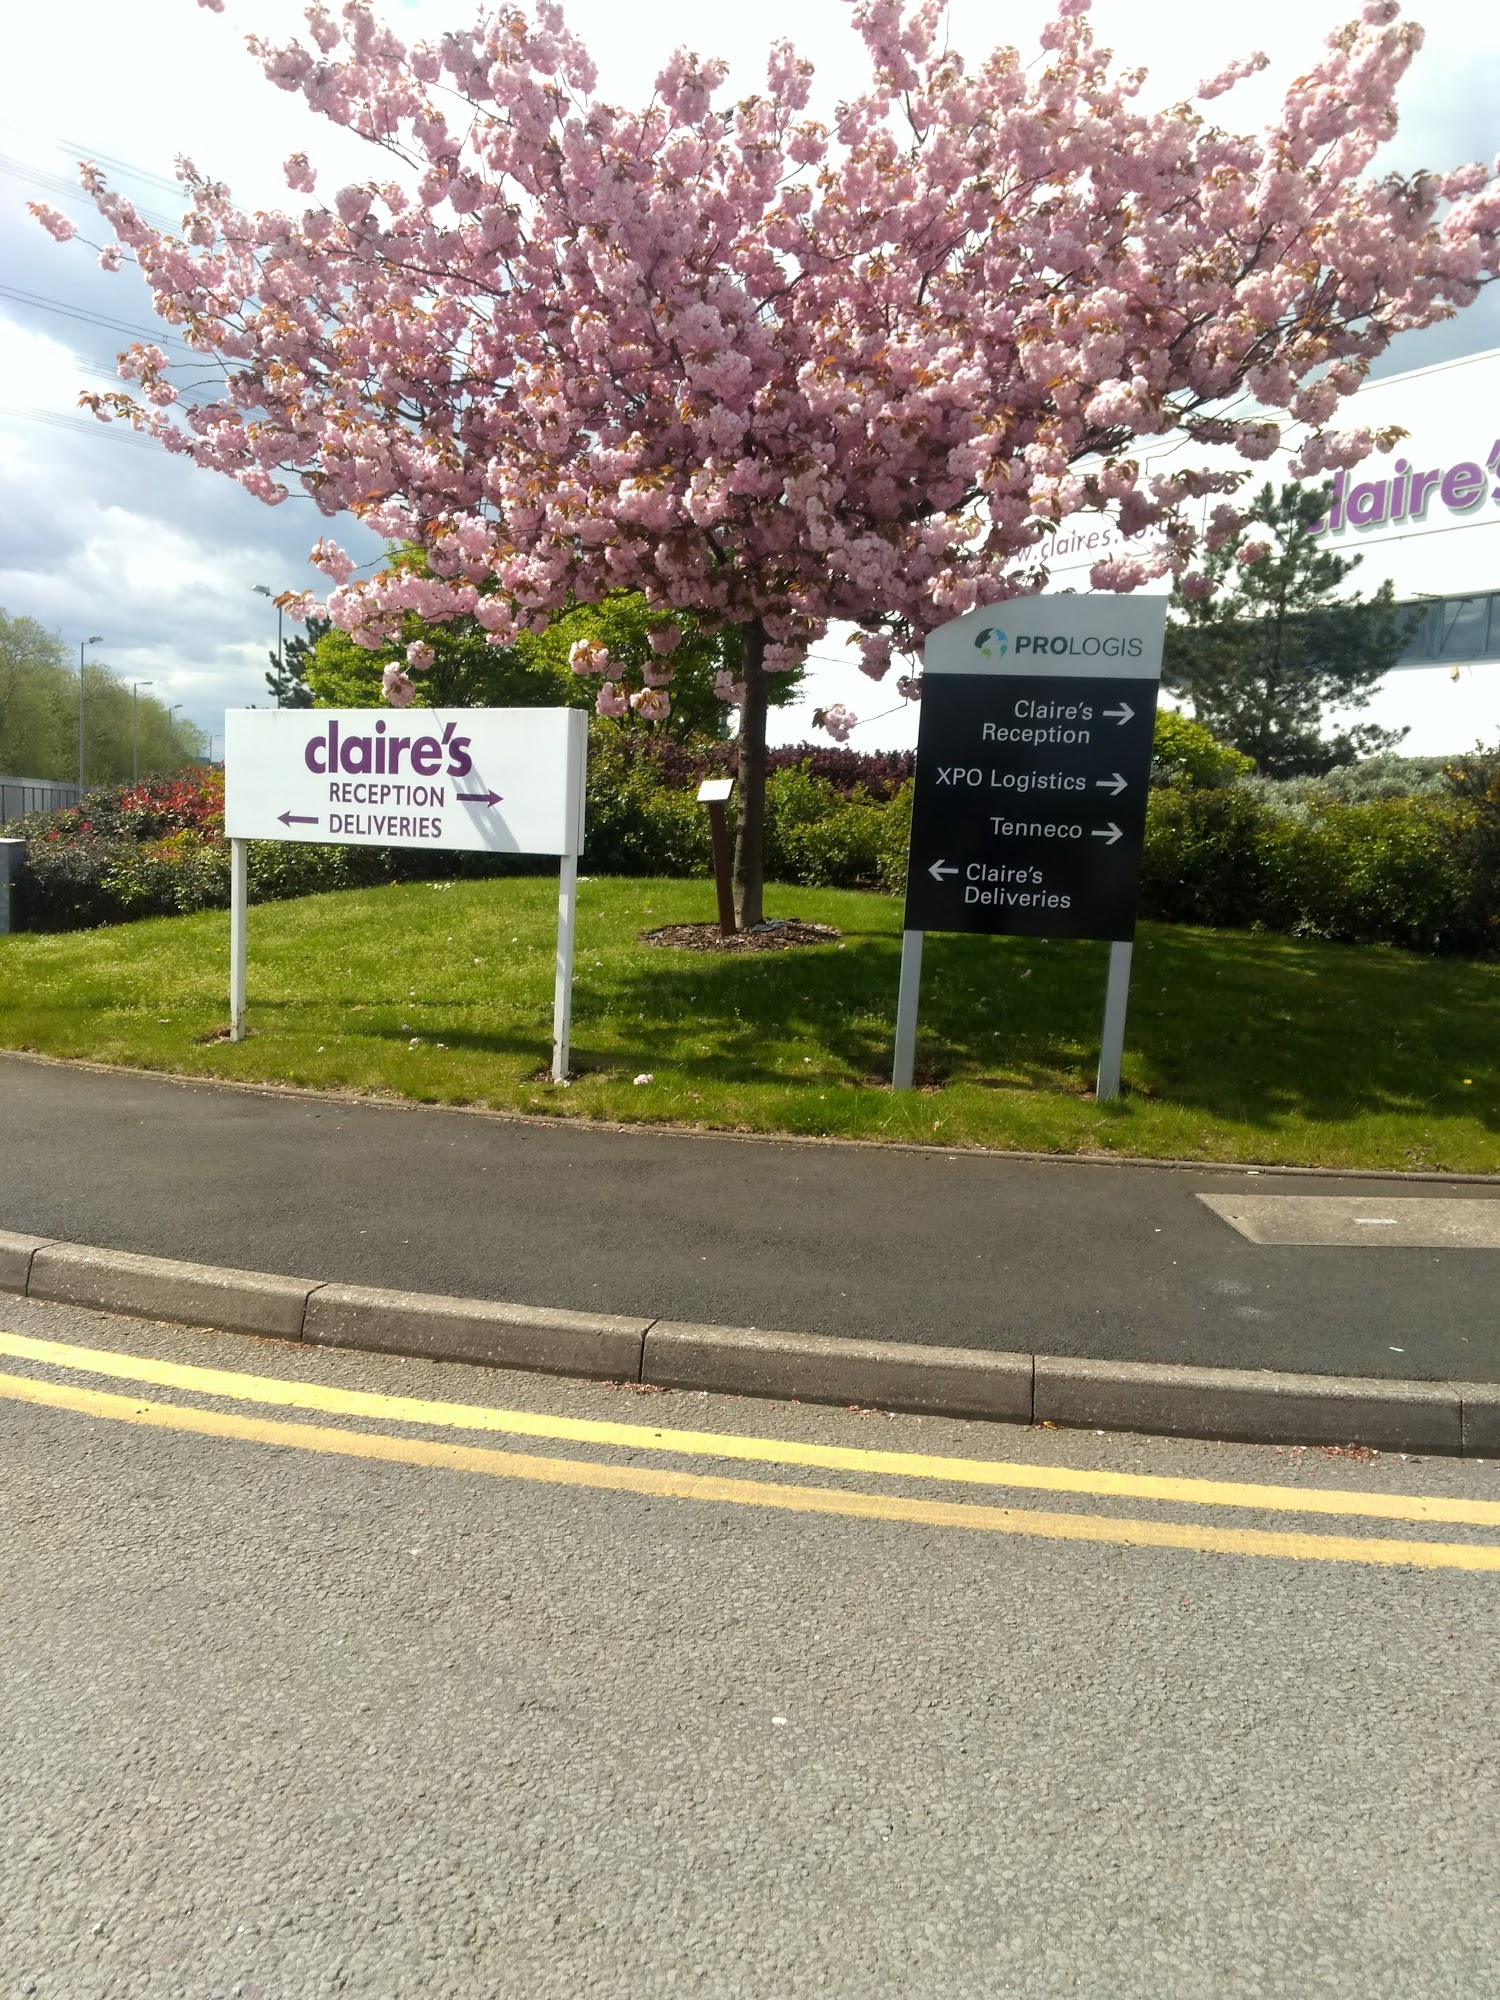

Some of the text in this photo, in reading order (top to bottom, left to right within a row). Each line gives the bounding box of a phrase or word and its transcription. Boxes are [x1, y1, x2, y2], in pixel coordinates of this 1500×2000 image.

[1306, 438, 1500, 534] laire'
[1014, 635, 1143, 657] PROLOGIS
[1014, 700, 1093, 720] Claire's
[982, 723, 1091, 745] Reception
[304, 719, 472, 777] claire's
[935, 767, 1087, 793] XPO Logistics
[329, 782, 445, 808] RECEPTION
[329, 814, 443, 838] DELIVERIES
[990, 817, 1083, 839] Tenneco
[966, 864, 1044, 884] Claire's
[964, 886, 1071, 909] Deliveries
